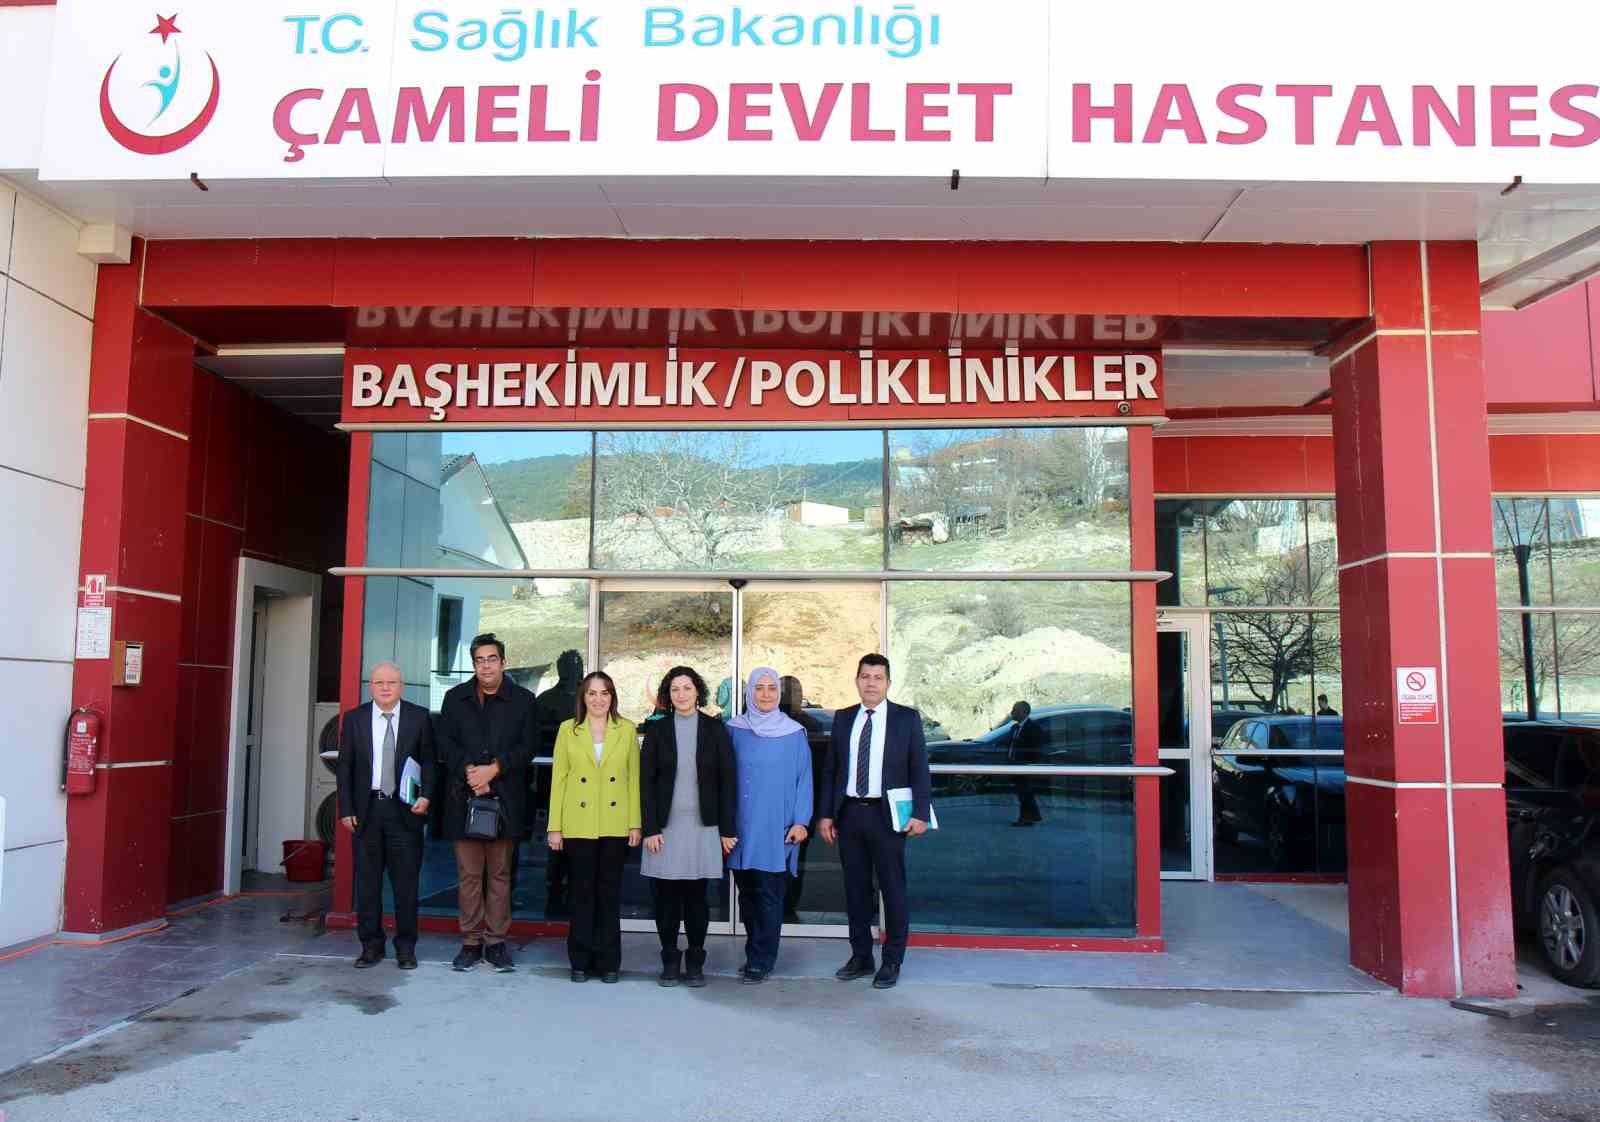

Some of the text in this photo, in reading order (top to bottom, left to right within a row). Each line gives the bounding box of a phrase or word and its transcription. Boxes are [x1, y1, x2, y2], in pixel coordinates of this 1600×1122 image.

[284, 6, 940, 62] T.C. Sağlık Bakanlığı
[273, 69, 1600, 163] ÇAMELİ DEVLET HASTANES
